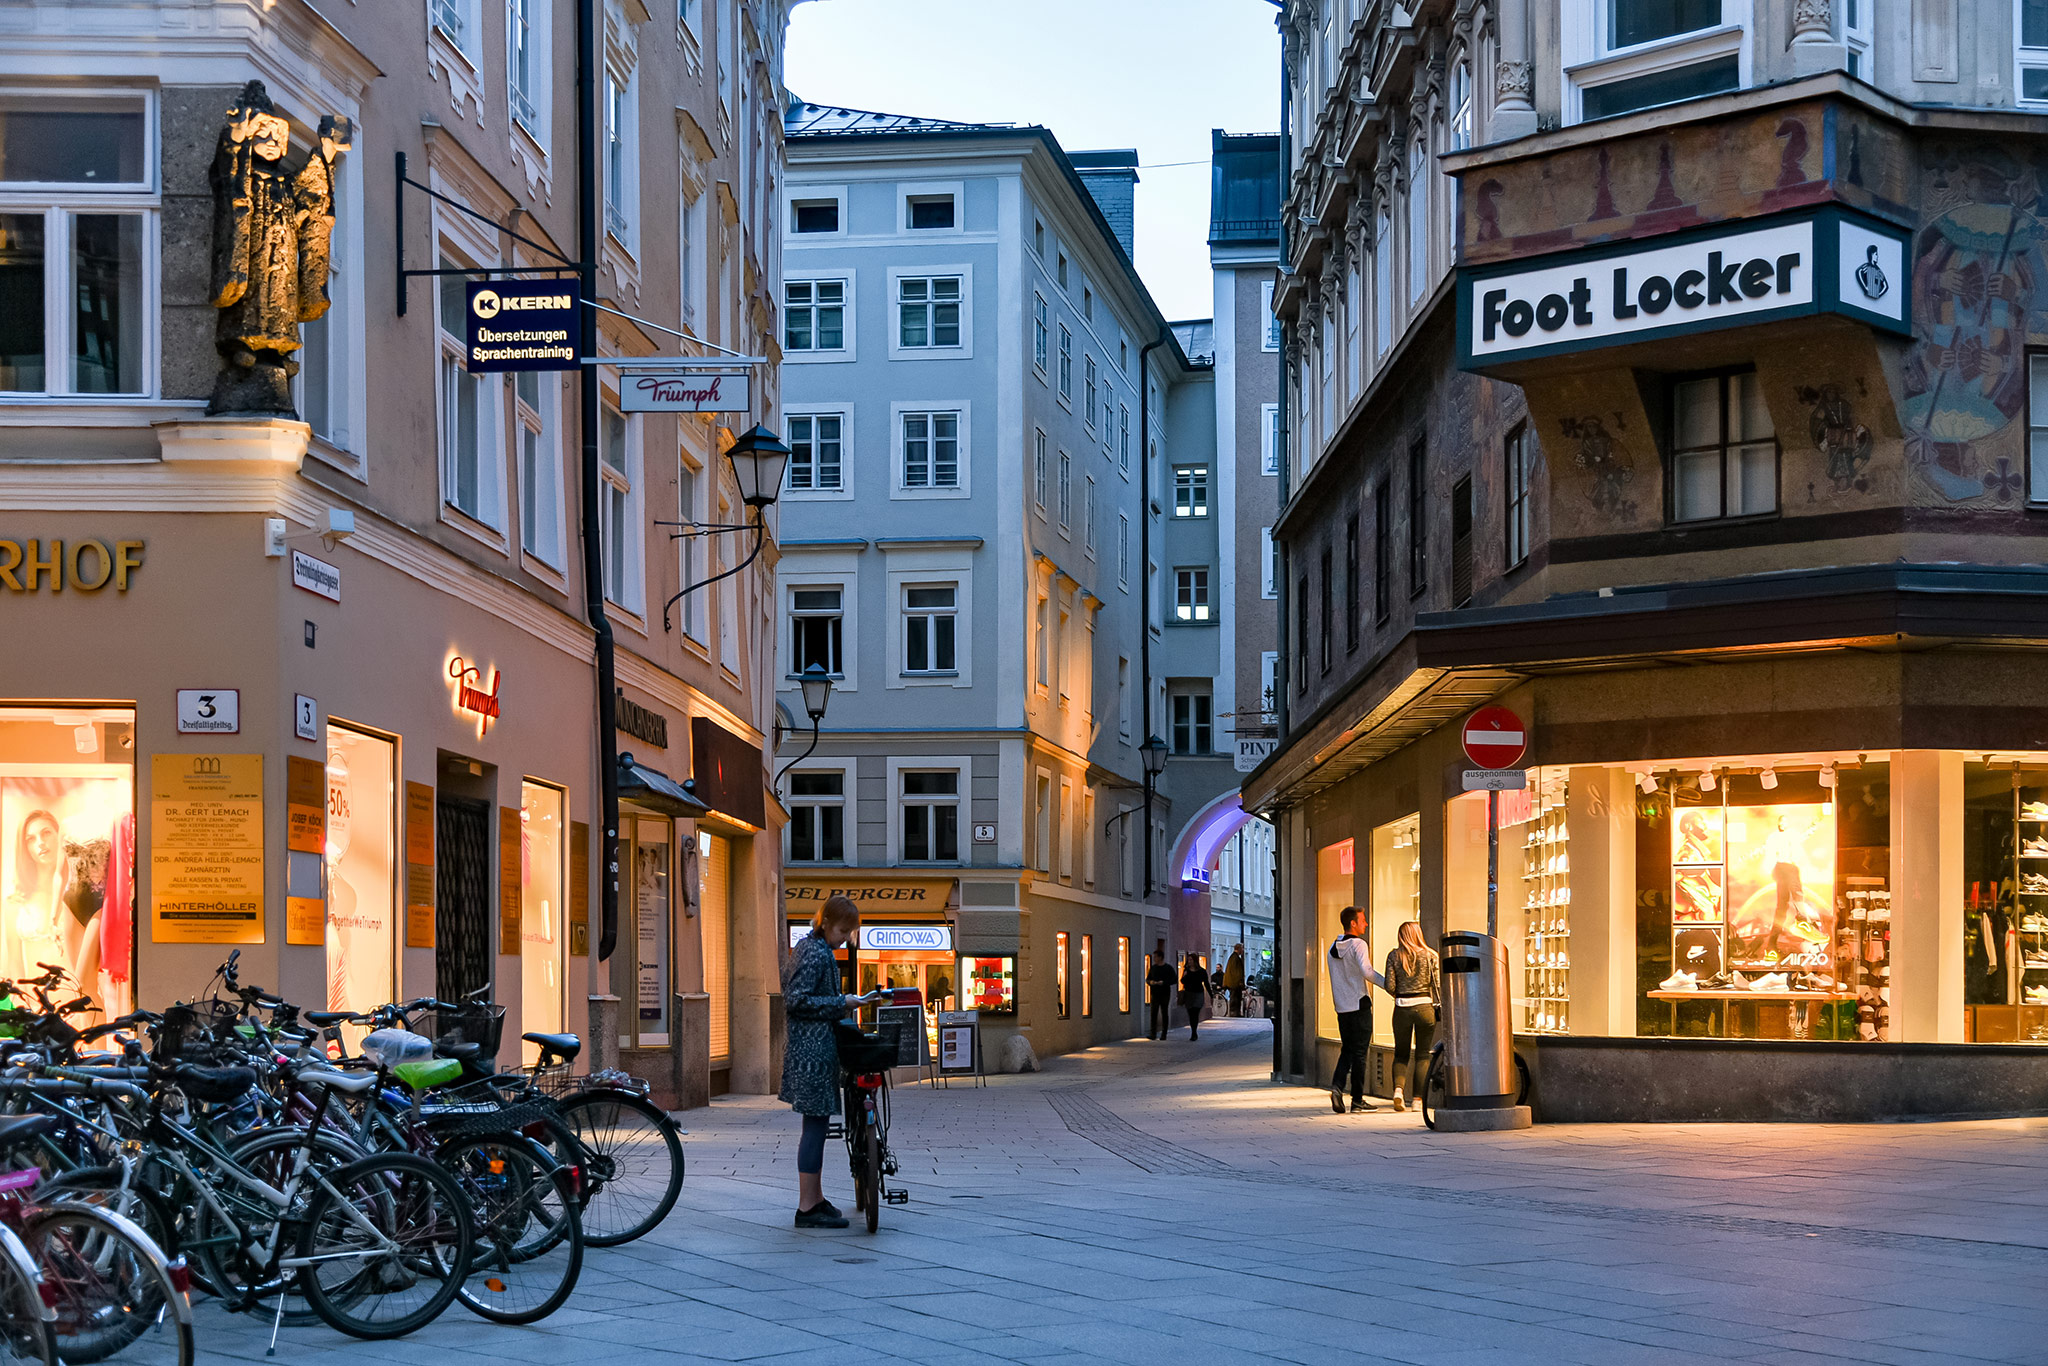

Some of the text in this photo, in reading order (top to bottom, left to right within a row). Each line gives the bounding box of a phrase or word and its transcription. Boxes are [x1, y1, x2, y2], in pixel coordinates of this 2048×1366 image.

[502, 295, 572, 311] KERN
[1482, 251, 1801, 342] Foot Locker
[477, 326, 568, 344] Übersetzungen
[472, 345, 574, 364] Sprachentraining
[636, 376, 722, 411] Triumph
[0, 539, 146, 592] RHOF
[449, 656, 501, 735] Triumph
[197, 694, 217, 718] 3
[303, 702, 312, 725] 3
[1240, 742, 1277, 756] PINT
[1465, 770, 1524, 779] ausgenommen
[327, 788, 350, 818] -50%
[981, 826, 988, 836] 5
[159, 901, 257, 911] HINTERHÖLLER
[876, 931, 936, 945] RIMOWA
